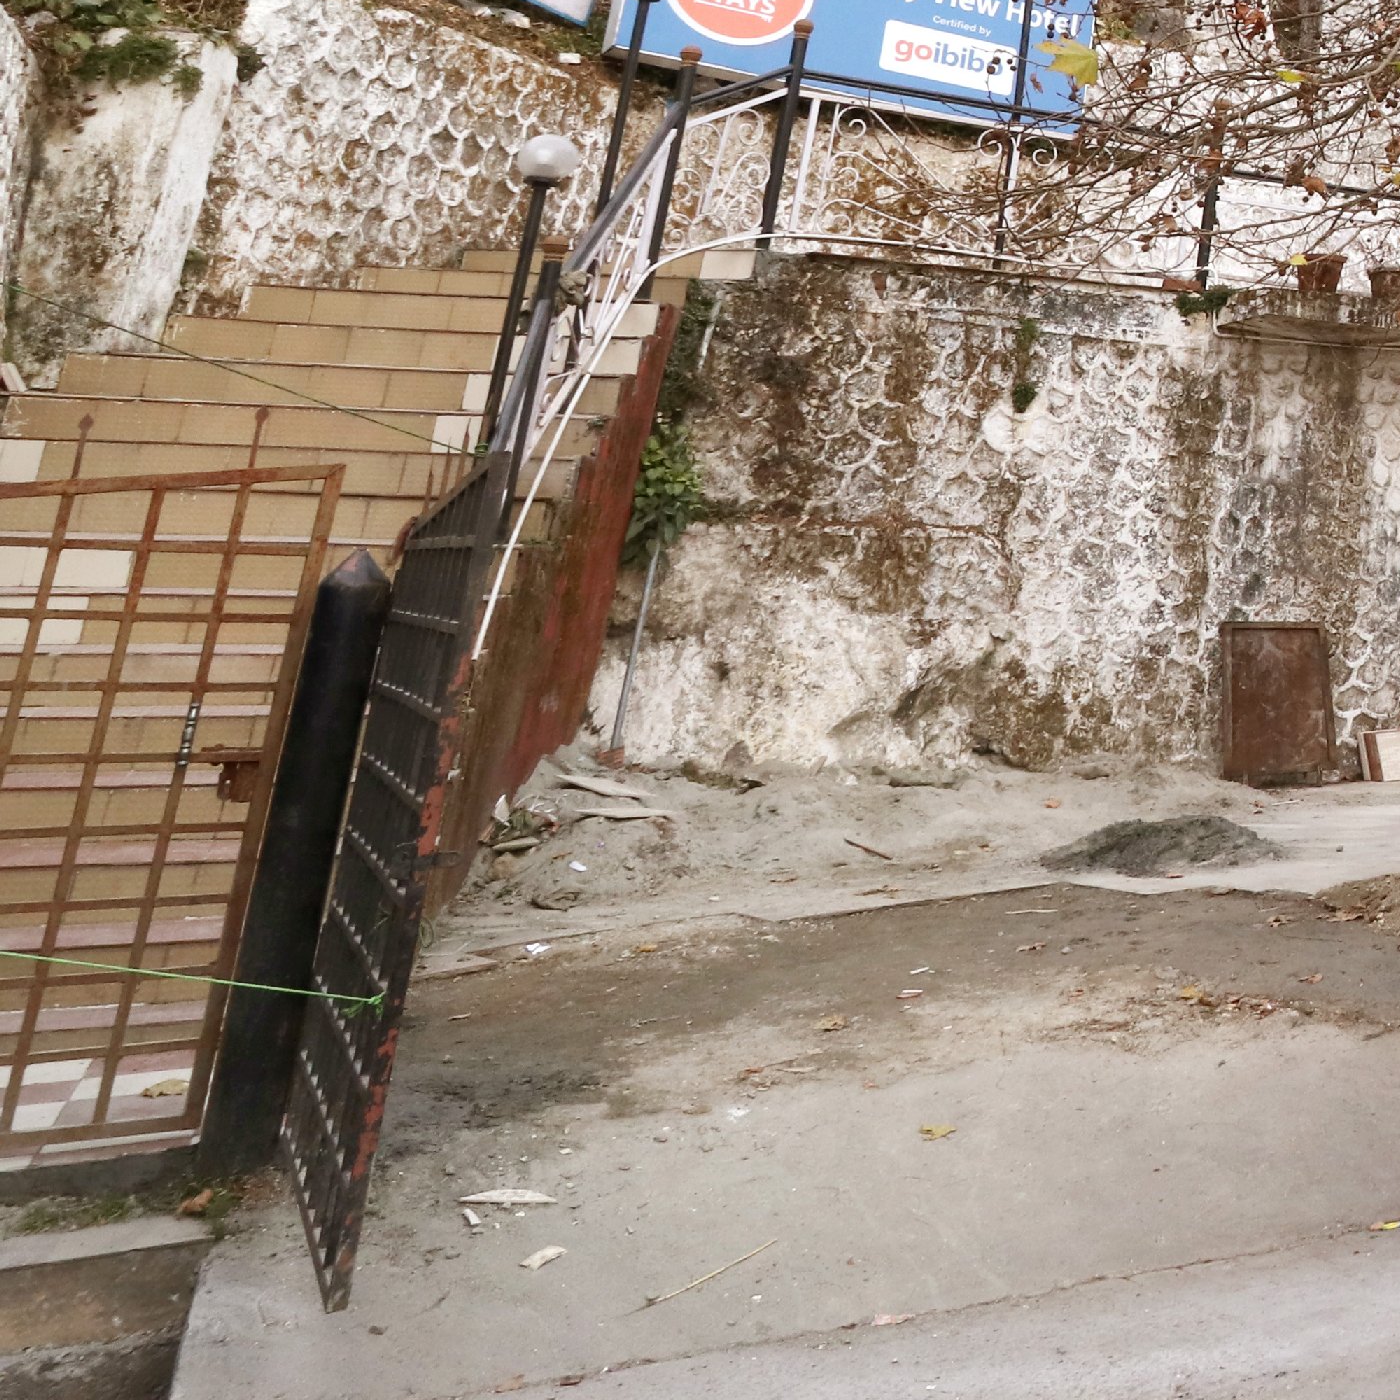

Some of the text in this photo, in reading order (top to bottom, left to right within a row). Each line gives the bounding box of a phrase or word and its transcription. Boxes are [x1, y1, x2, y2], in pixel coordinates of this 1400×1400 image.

[932, 14, 991, 37] Certified by
[1006, 1, 1080, 38] Hotel
